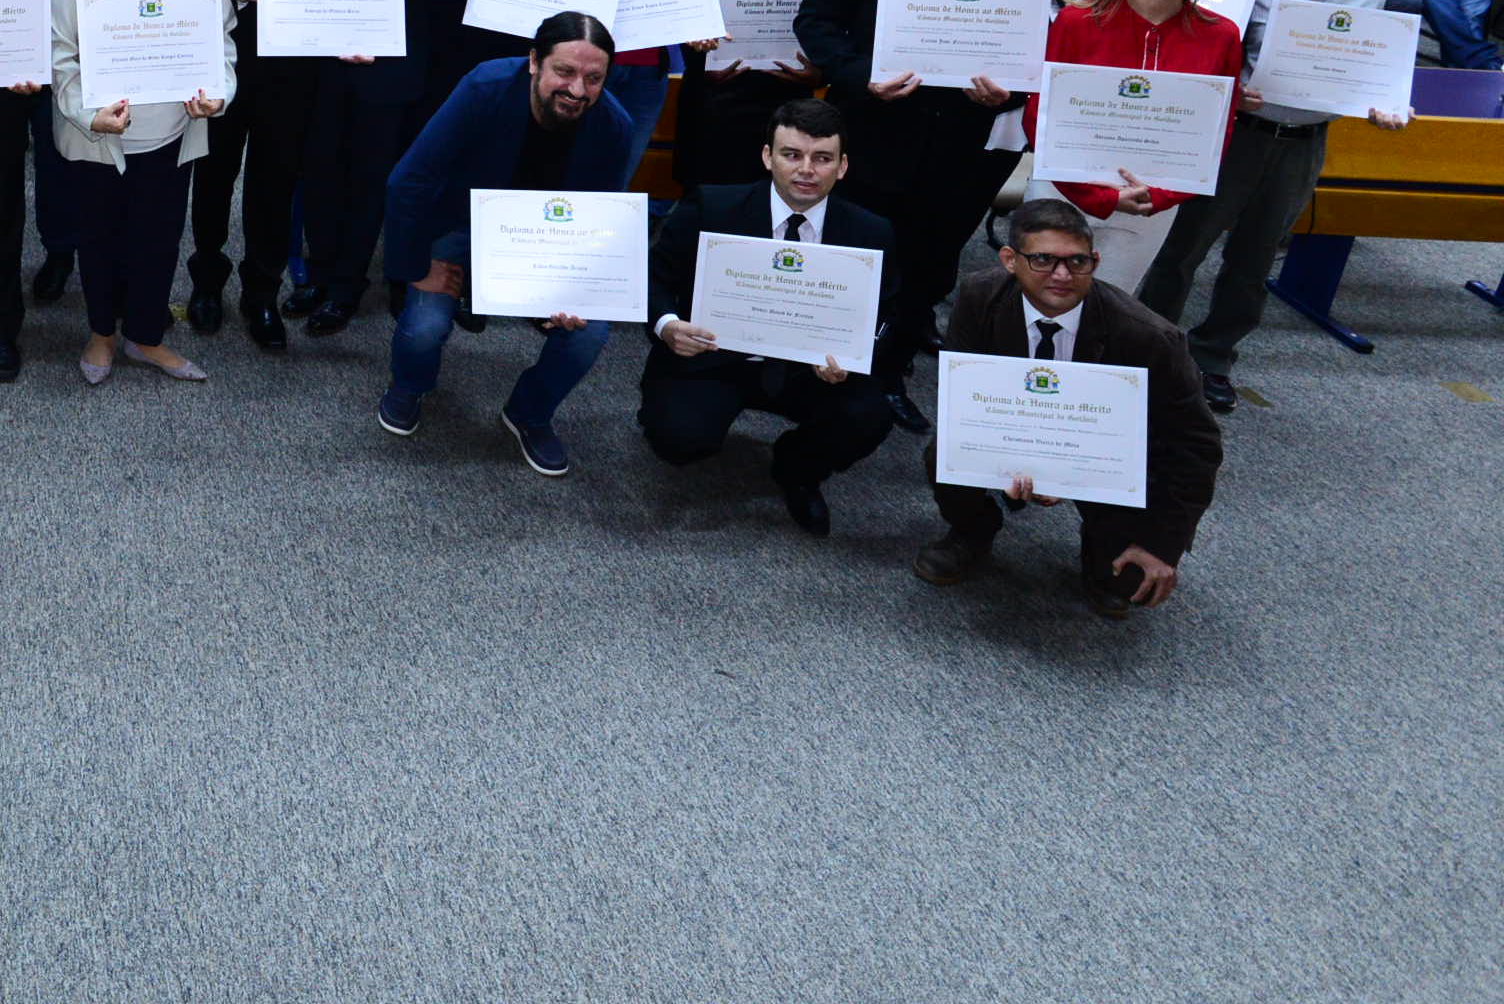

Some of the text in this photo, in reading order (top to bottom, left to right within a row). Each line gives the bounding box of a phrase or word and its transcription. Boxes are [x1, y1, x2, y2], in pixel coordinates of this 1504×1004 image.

[907, 3, 941, 14] Diploma
[955, 6, 980, 16] Honra
[995, 7, 1023, 17] Mérito
[725, 268, 760, 282] Diploma
[774, 274, 801, 287] Honra
[817, 280, 848, 293] Mérito
[972, 392, 1012, 407] Diploma
[1030, 398, 1060, 411] Honra
[1079, 402, 1112, 415] Mérito
